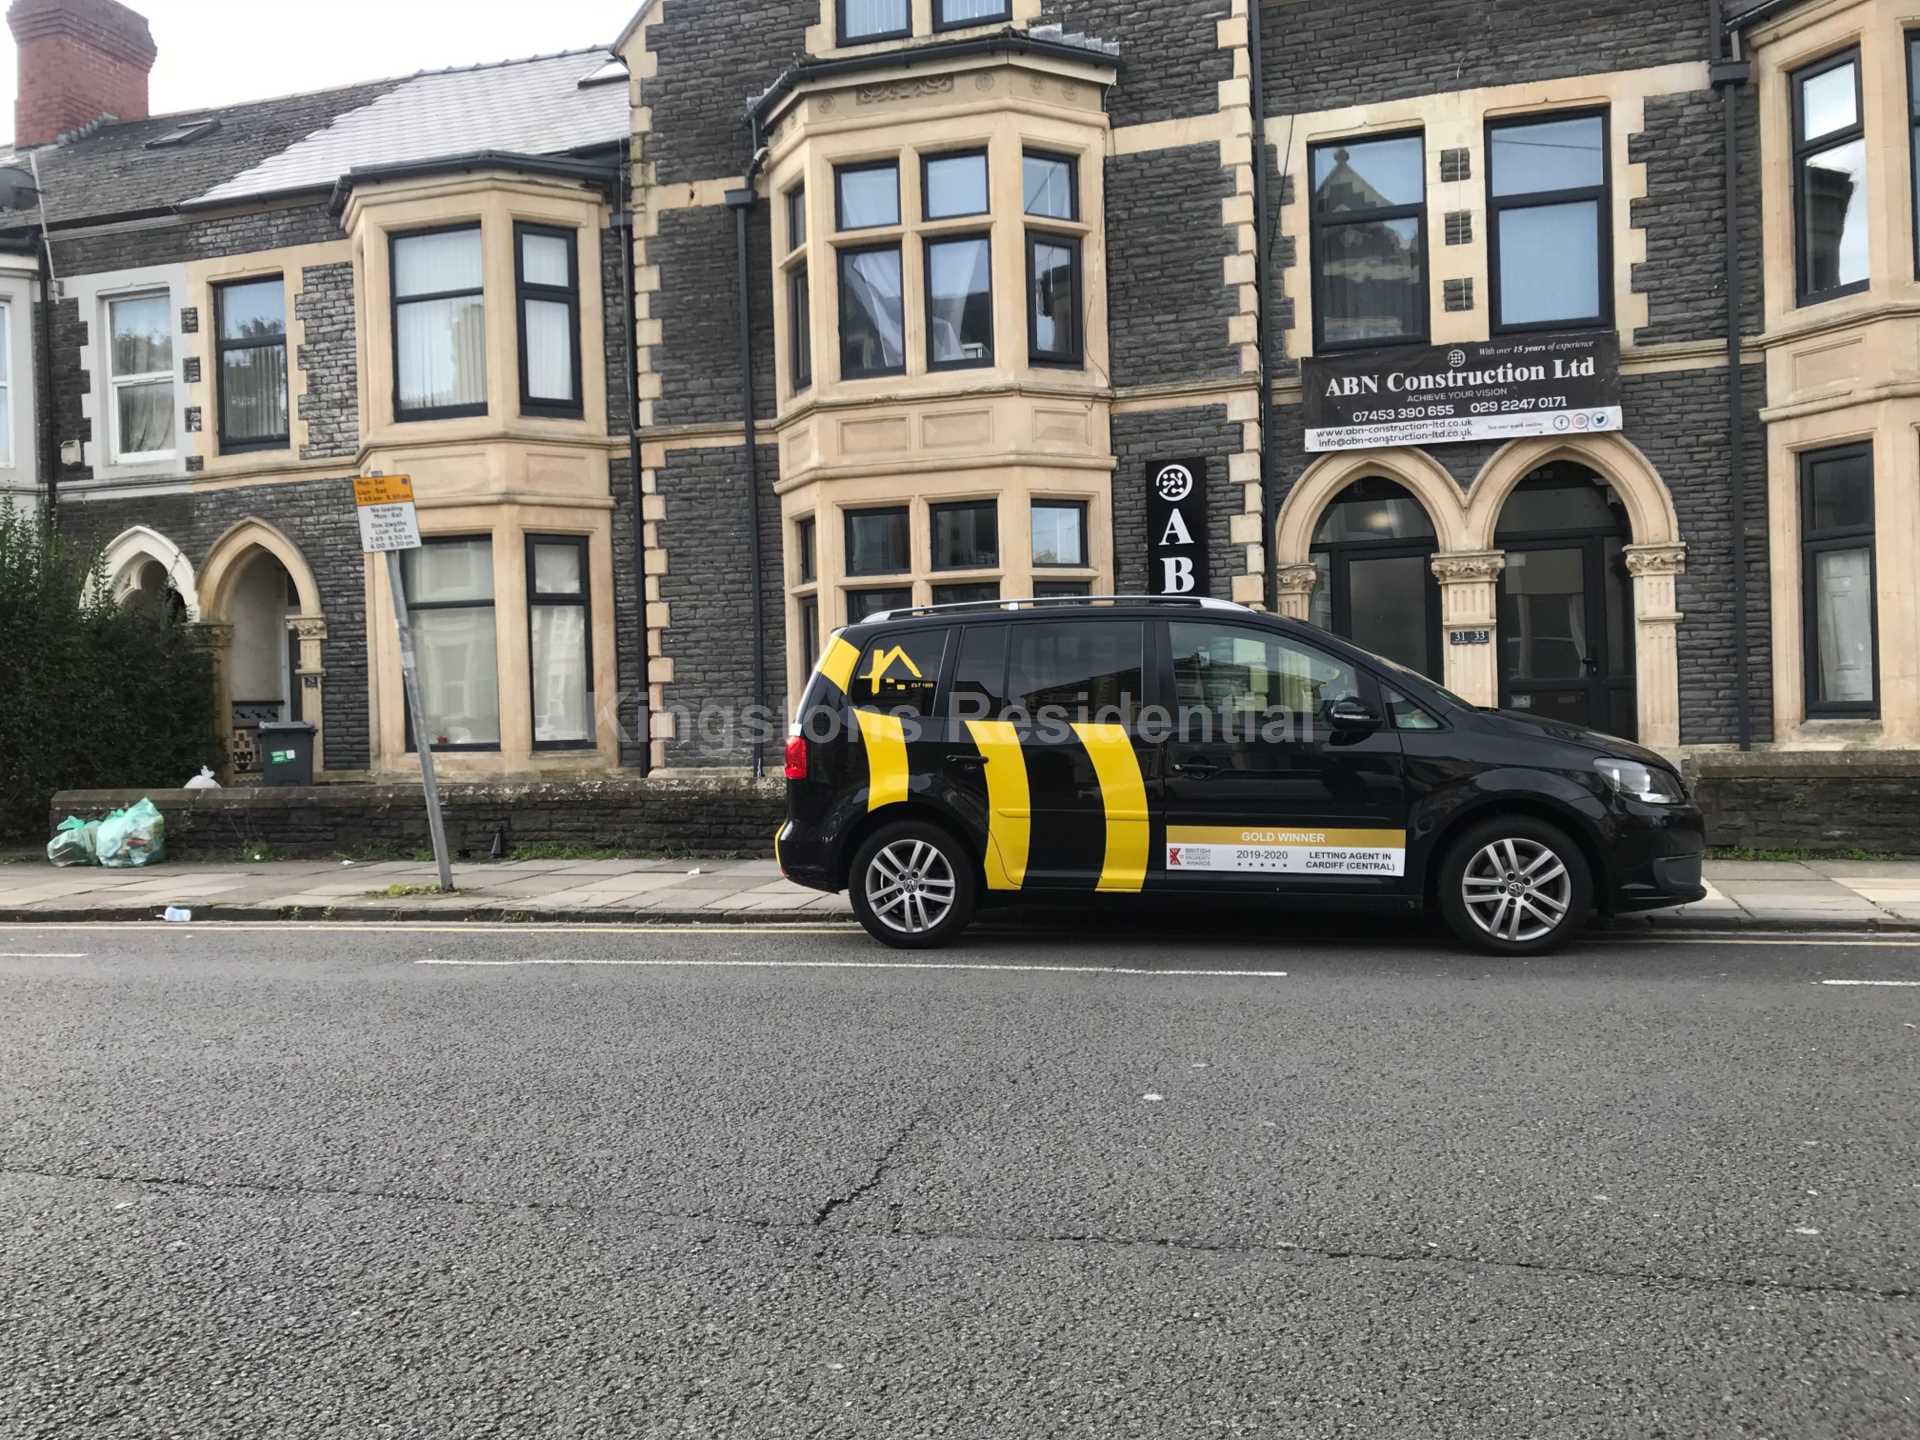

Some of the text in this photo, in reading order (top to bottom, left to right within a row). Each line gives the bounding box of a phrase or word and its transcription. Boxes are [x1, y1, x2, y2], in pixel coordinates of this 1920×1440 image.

[1480, 347, 1495, 356] With
[1524, 345, 1546, 354] years
[1547, 343, 1555, 351] of
[1555, 341, 1594, 351] experience
[1325, 356, 1595, 397] ABN Construction Ltd
[1407, 387, 1508, 402] ACHIEVE YOUR VISION
[1470, 396, 1567, 413] 029 2247 0171
[1352, 404, 1455, 422] 07453 390 655
[1316, 418, 1473, 438] www.abn-construction-ltd.co.uk
[1318, 427, 1473, 448] info@abn-construction-ltd.co.uk
[1455, 630, 1486, 641] 31 33
[1241, 831, 1326, 844] GOLD WINNER
[1236, 850, 1289, 861] 2019-2020
[1309, 851, 1392, 860] LETTING AGENT IN
[1305, 861, 1395, 872] CARDIFF (CENTRAL)
